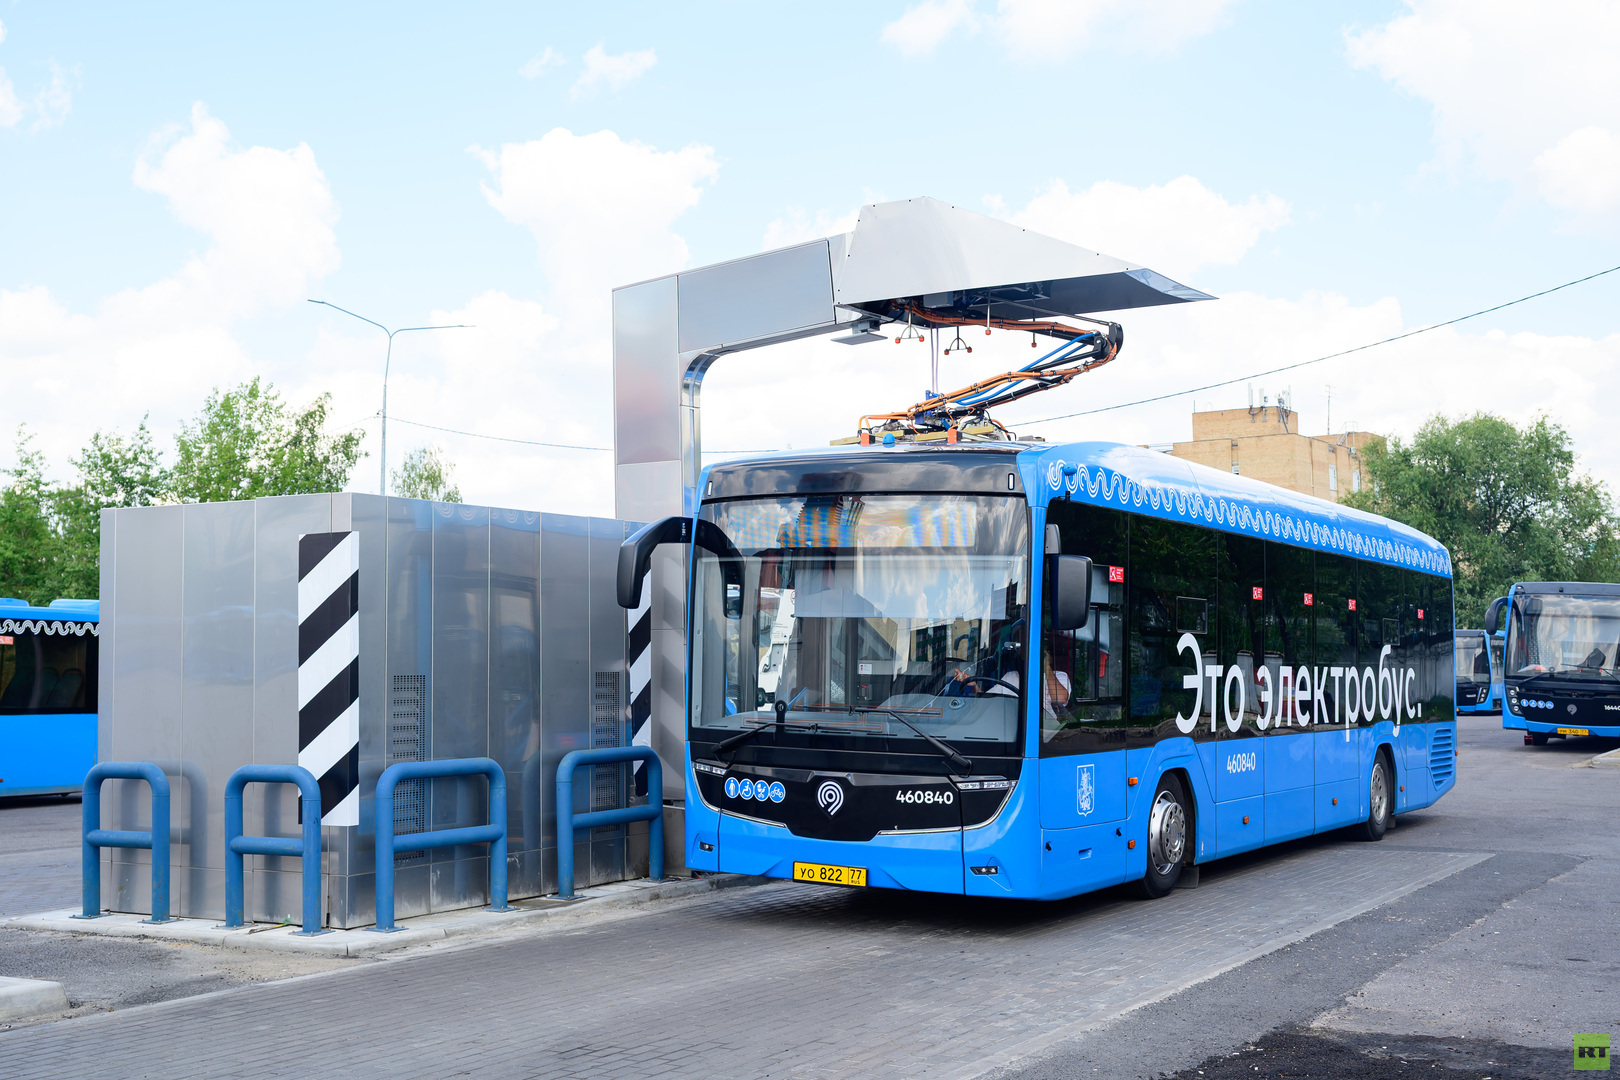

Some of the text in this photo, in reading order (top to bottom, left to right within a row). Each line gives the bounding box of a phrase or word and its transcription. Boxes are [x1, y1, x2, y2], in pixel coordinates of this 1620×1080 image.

[1175, 632, 1422, 743] Это электробус.
[1226, 752, 1256, 774] 460840
[895, 790, 954, 805] 460840
[820, 867, 843, 882] 822
[850, 869, 862, 880] 77
